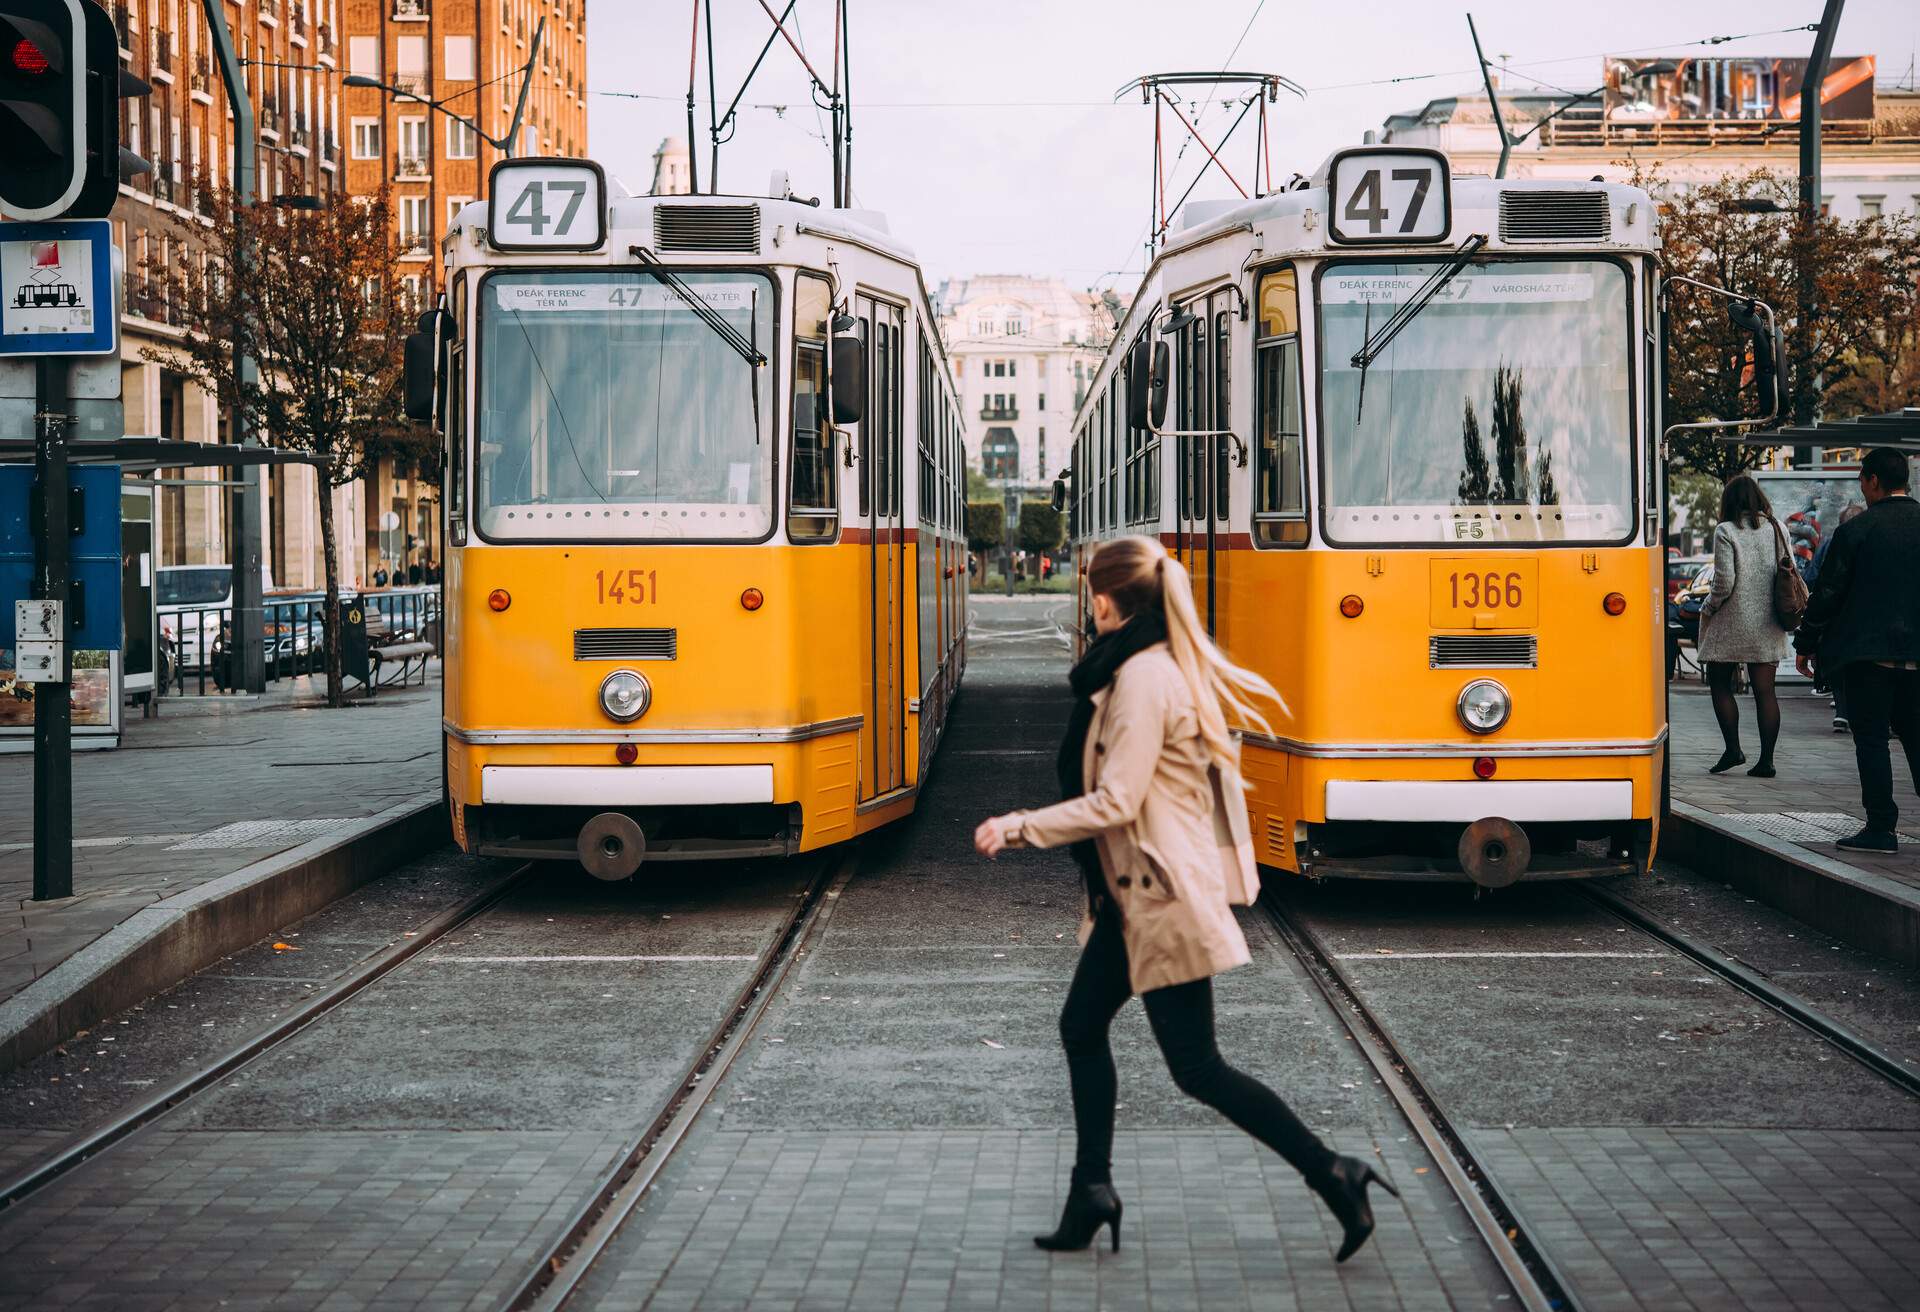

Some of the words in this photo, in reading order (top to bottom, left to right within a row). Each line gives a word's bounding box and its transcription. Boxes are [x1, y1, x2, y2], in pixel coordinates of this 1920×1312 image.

[506, 181, 587, 236] 47
[1345, 168, 1432, 234] 47
[516, 287, 544, 297] DEÁK
[547, 289, 586, 297] FERENC
[1339, 279, 1369, 289] DEÁK
[1372, 280, 1413, 289] FERENC
[1435, 279, 1473, 299] 47
[1493, 283, 1552, 293] VÁROSHÁZ
[536, 297, 555, 307] TÉR
[558, 299, 568, 307] M
[608, 288, 643, 307] 47
[1358, 289, 1378, 299] TÉR
[1382, 291, 1392, 299] M
[1454, 521, 1484, 539] F5
[596, 569, 657, 605] 1451
[1449, 572, 1522, 608] 1366
